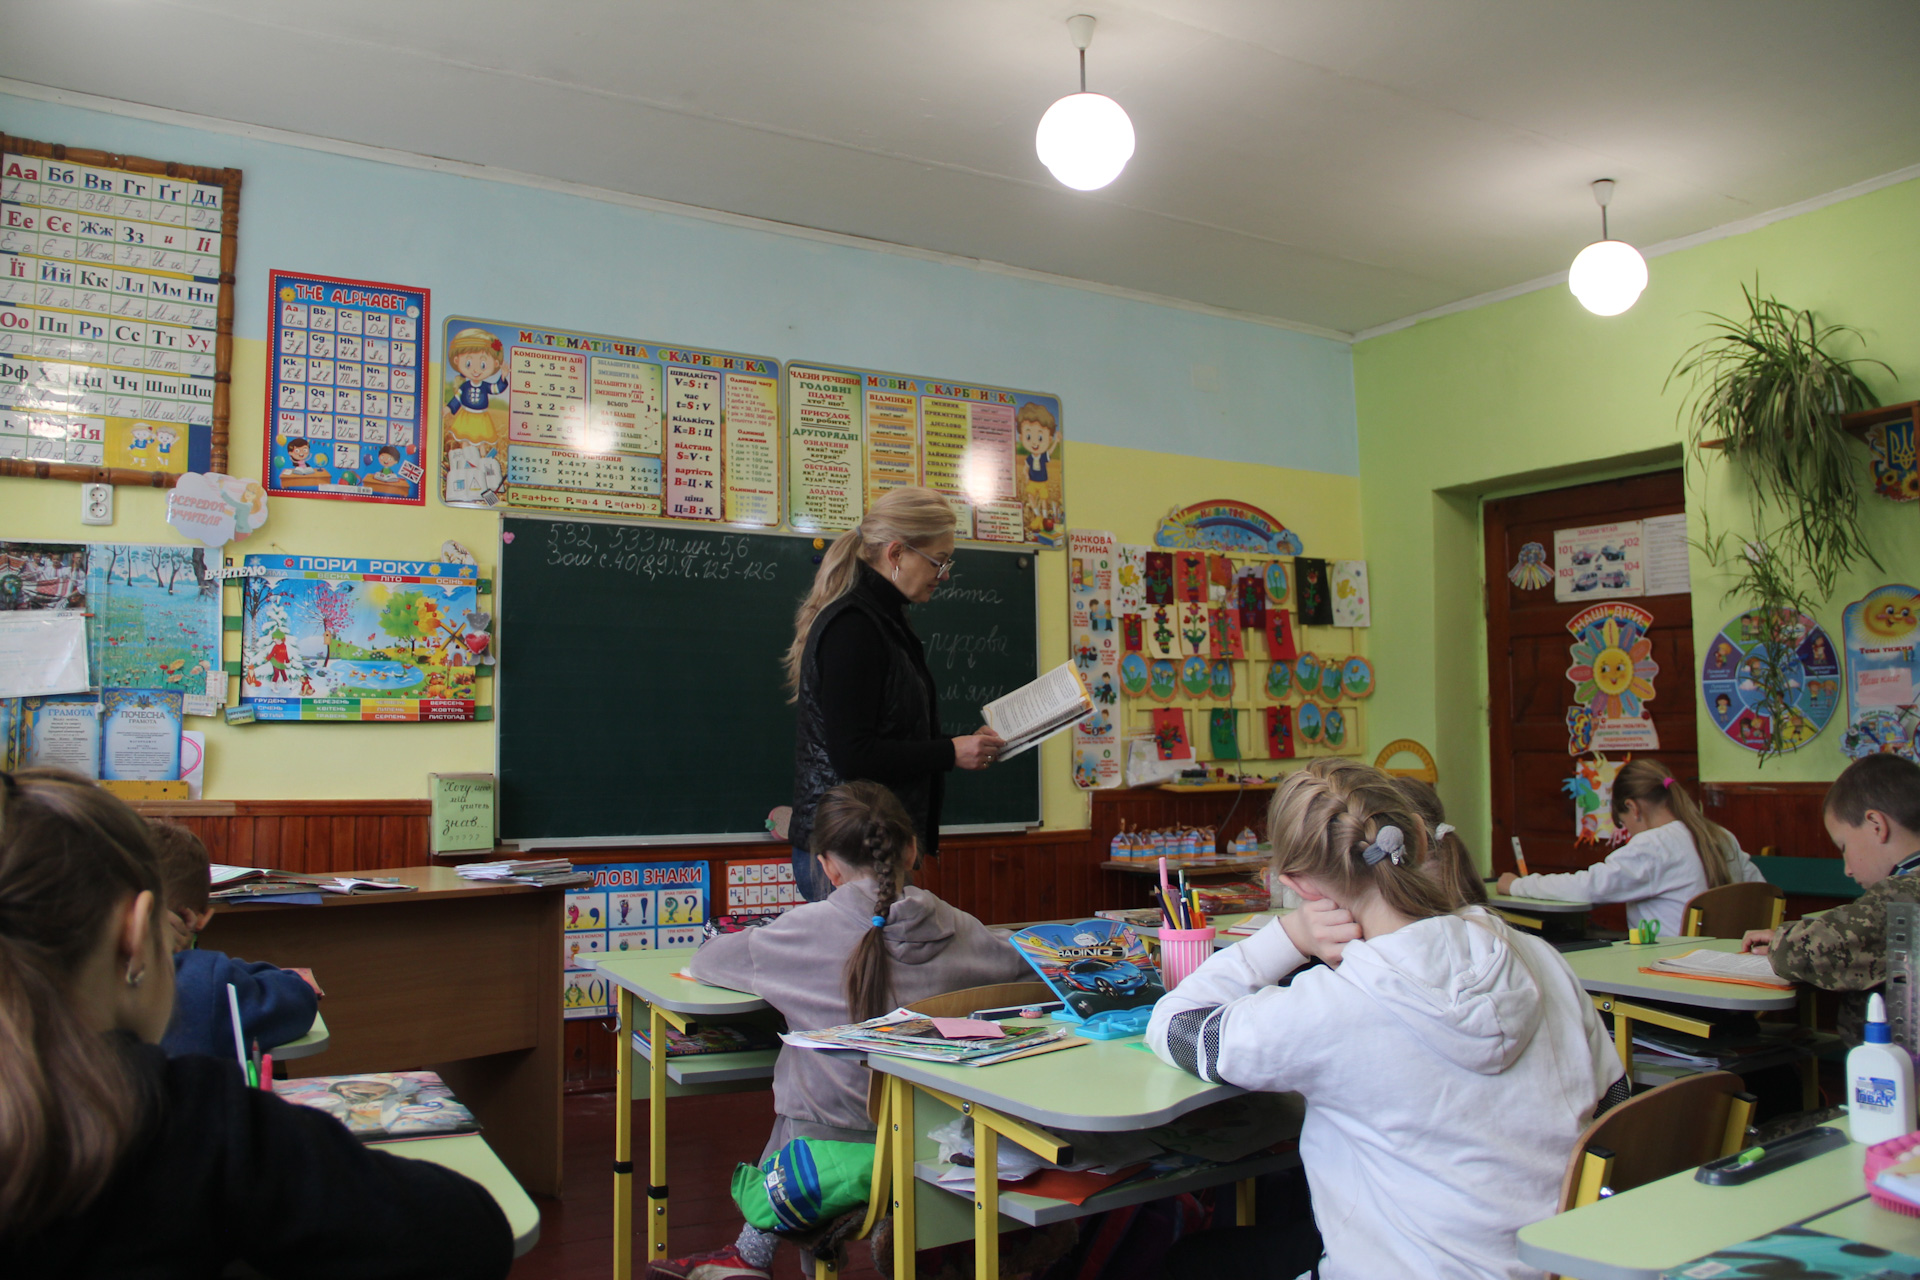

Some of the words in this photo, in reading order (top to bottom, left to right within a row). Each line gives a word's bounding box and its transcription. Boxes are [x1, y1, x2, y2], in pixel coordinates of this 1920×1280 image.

[6, 163, 38, 180] Аа
[48, 166, 74, 184] Бб
[84, 173, 112, 191] Вв
[123, 179, 145, 195] Гг
[191, 190, 217, 208] Дд
[7, 211, 34, 228] Ее
[47, 216, 72, 233] Єє
[80, 221, 113, 236] Жж
[123, 227, 144, 244] Зз
[10, 258, 25, 277] Її
[41, 262, 72, 283] Йй
[80, 270, 108, 288] Кк
[116, 277, 144, 293] Лл
[151, 282, 181, 297] Мм
[188, 287, 214, 303] Нн
[296, 285, 323, 301] THE
[331, 289, 407, 311] ALPHABET
[0, 312, 29, 329] Оо
[39, 316, 68, 333] Пп
[79, 321, 103, 339] Рр
[115, 326, 140, 342] Сс
[152, 330, 176, 346] Тт
[188, 334, 210, 352] Уу
[312, 334, 325, 342] Gg
[394, 344, 402, 352] Jj
[514, 350, 567, 362] КОМПОНЕНТИ
[519, 330, 648, 358] МАТЕМАТИЧНА
[657, 349, 768, 373] СКАРБНИЧКА
[670, 370, 717, 380] швидкість
[790, 371, 820, 380] ЧЛЕНИ
[822, 375, 860, 385] РЕЧЕННЯ
[113, 376, 138, 390] Чч
[146, 380, 176, 394] Шш
[182, 383, 212, 398] Щщ
[800, 382, 851, 394] ГОЛОВНІ
[867, 376, 918, 392] МОВНА
[925, 383, 1016, 404] СКАРБНИЧКА
[808, 392, 843, 401] ПІДМЕТ
[673, 415, 715, 425] кількість
[801, 409, 851, 419] ПРИСУДОК
[792, 428, 858, 440] ДРУГОРЯДНІ
[675, 442, 712, 451] відстань
[676, 468, 712, 476] вартість
[1070, 534, 1112, 544] РАНКОВА
[1558, 546, 1573, 554] 101
[1624, 537, 1640, 547] 102
[1074, 544, 1108, 554] РУТИНА
[204, 566, 266, 580] ВЧИТЕЛЮ
[300, 558, 357, 572] ПОРИ
[370, 561, 425, 575] РОКУ
[1559, 568, 1574, 577] 103
[1624, 561, 1639, 571] 104
[1574, 607, 1609, 632] НАШІ
[121, 711, 166, 719] ПОЧЕСНА
[643, 867, 702, 884] ЗНАКИ
[1058, 949, 1113, 957] RACING
